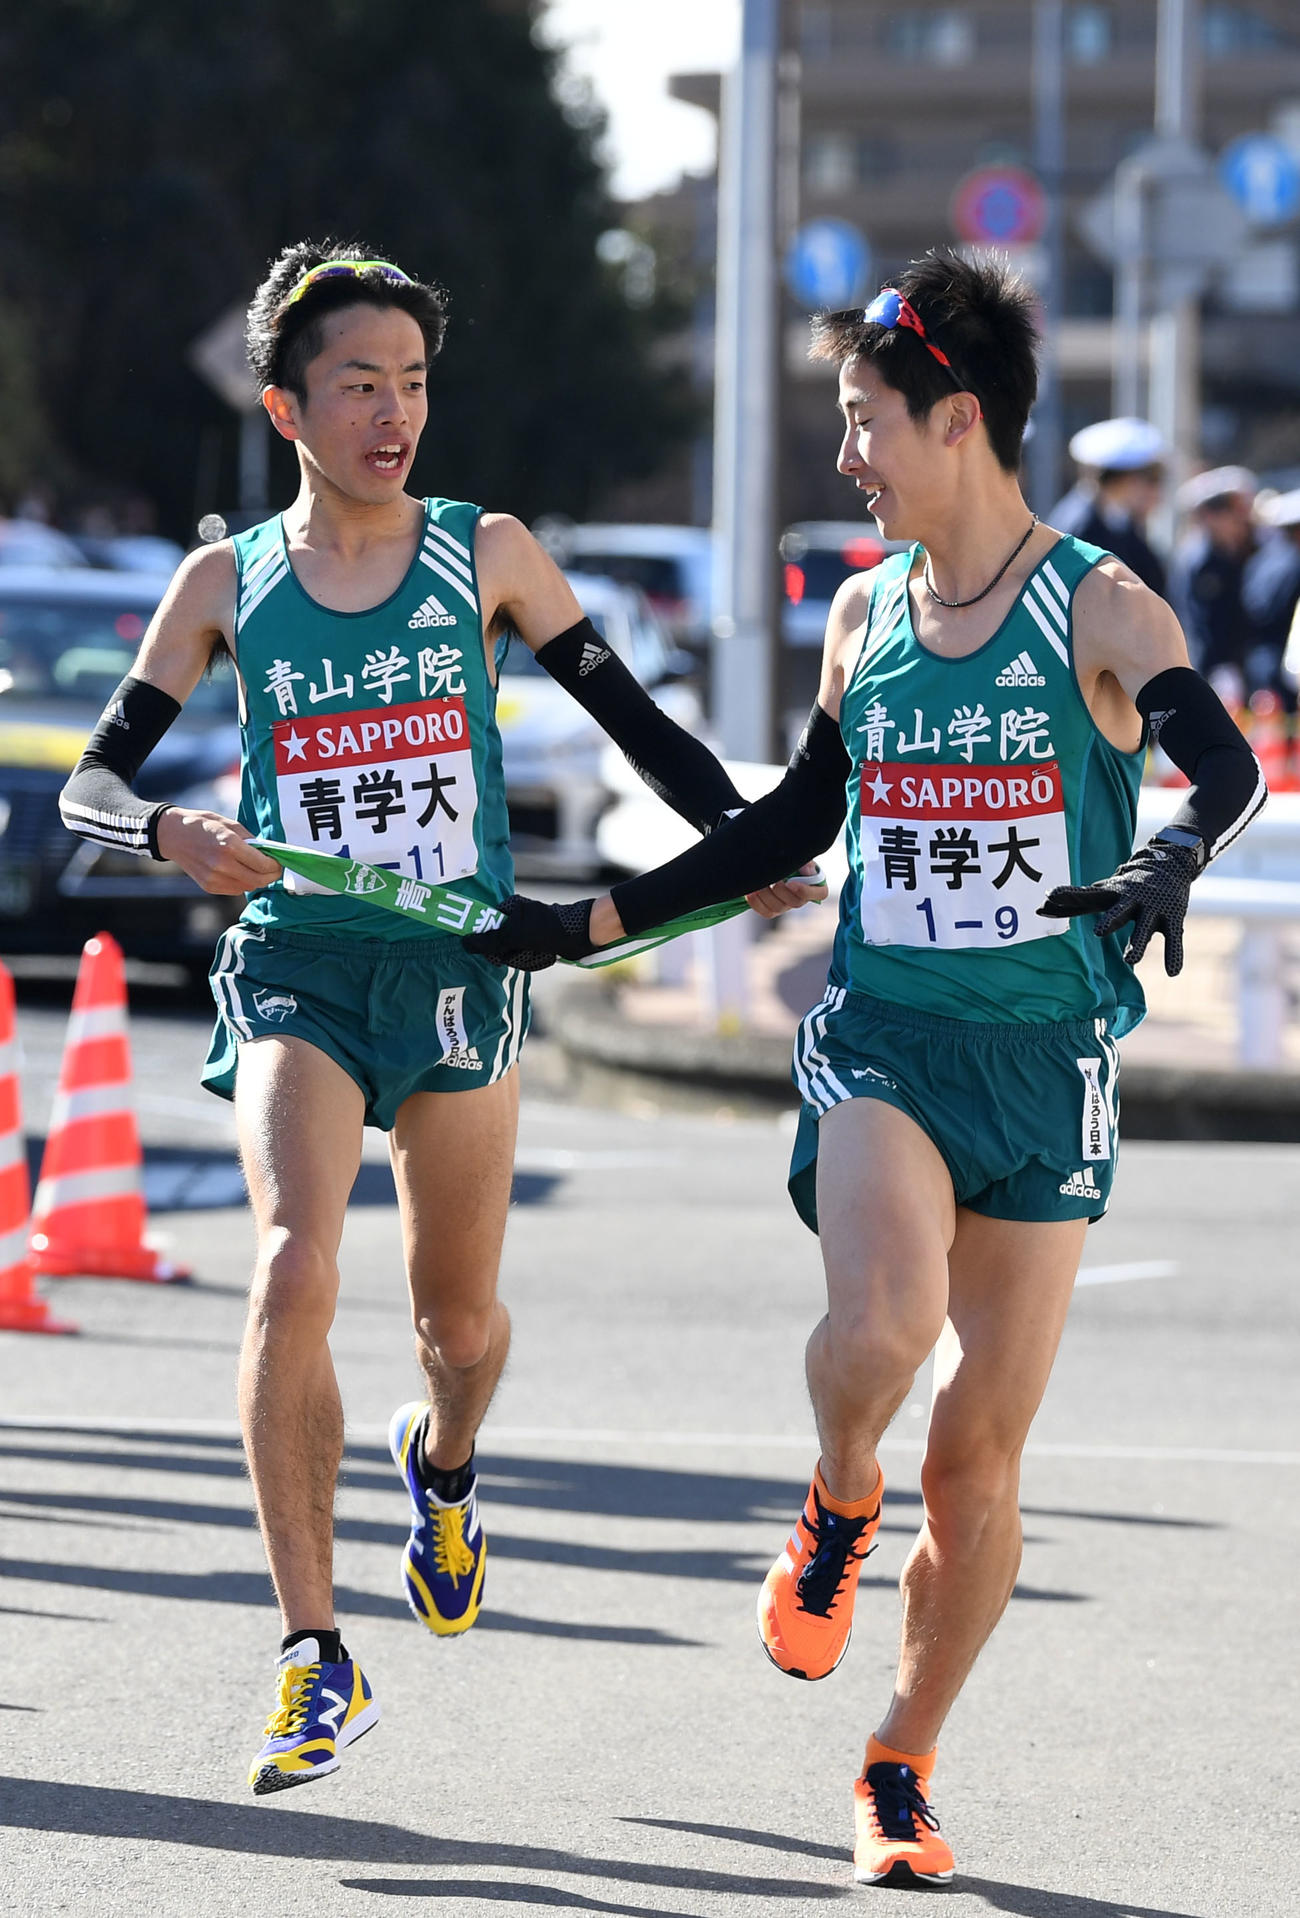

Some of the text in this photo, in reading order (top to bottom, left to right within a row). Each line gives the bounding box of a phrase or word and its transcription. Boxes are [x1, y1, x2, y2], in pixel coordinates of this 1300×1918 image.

[408, 615, 457, 629] adidas
[264, 644, 467, 716] 青山学院
[995, 674, 1046, 687] adidas
[315, 709, 464, 759] SAPPORO
[856, 702, 1055, 763] 青山学院
[299, 762, 459, 841] 青学大
[901, 774, 1054, 809] SAPPORO
[878, 825, 1043, 891] 青学大
[916, 897, 1018, 942] 1-9
[1059, 1183, 1101, 1199] adidas
